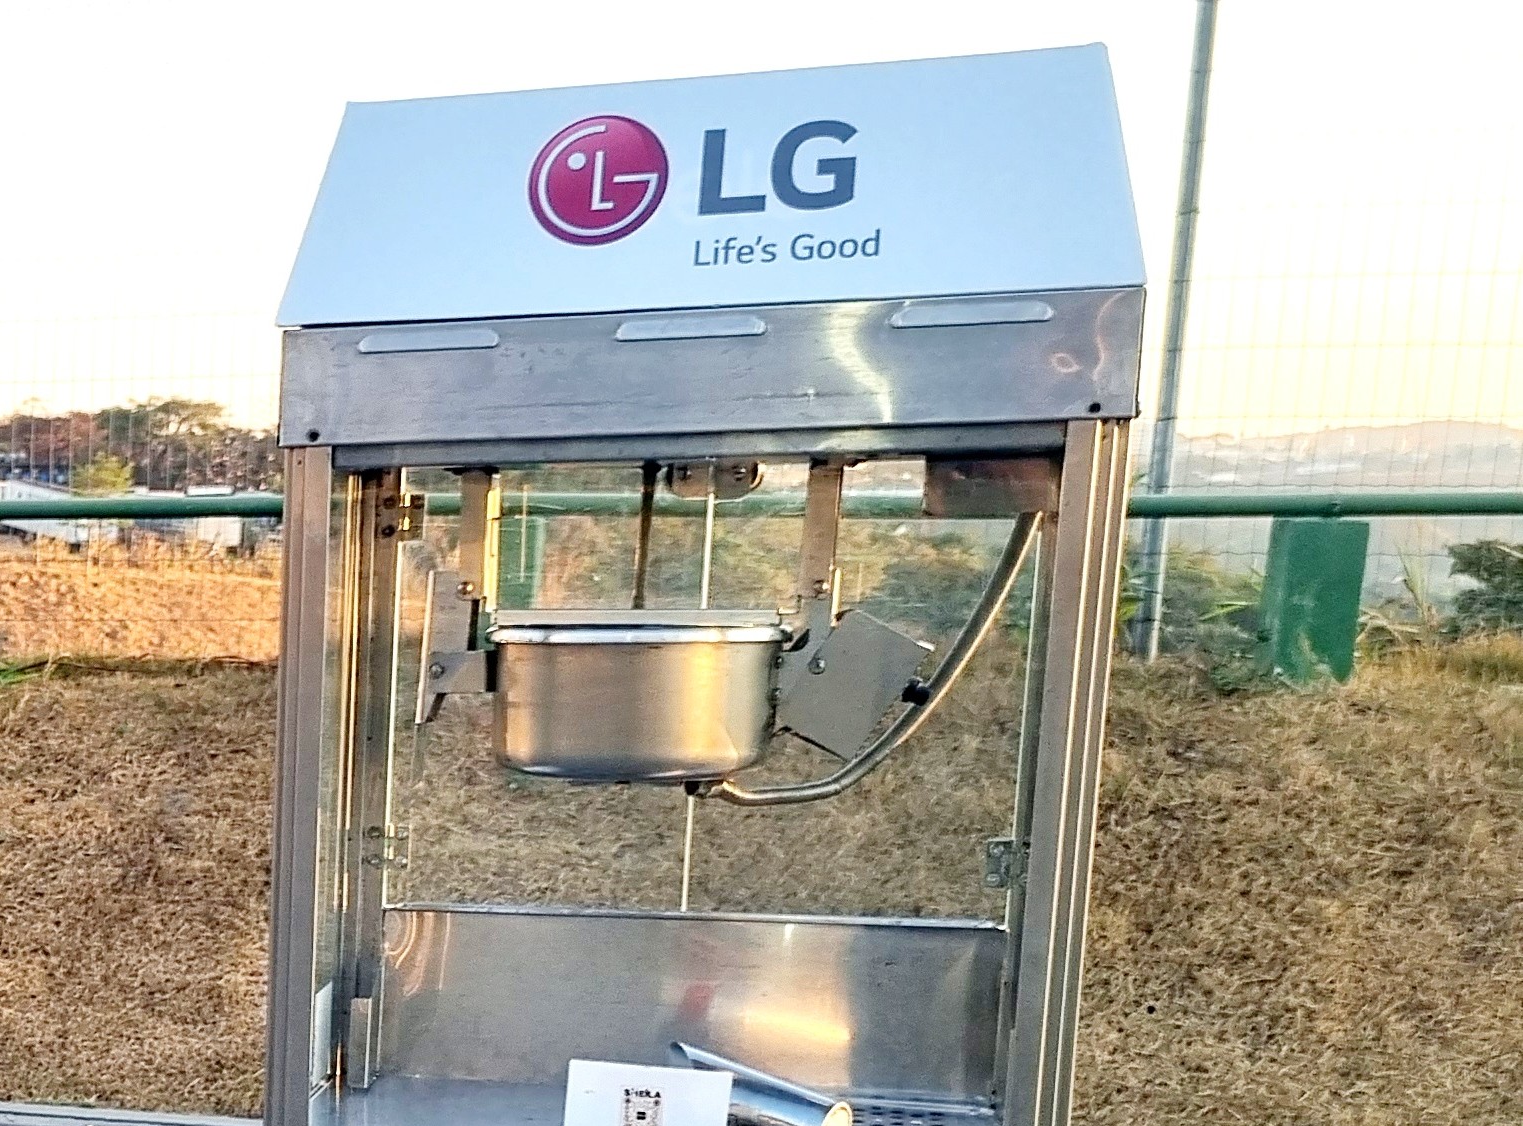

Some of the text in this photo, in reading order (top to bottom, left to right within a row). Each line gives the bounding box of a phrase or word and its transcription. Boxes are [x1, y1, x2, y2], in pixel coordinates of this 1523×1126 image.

[698, 119, 857, 216] LG
[693, 228, 881, 266] Life's Good
